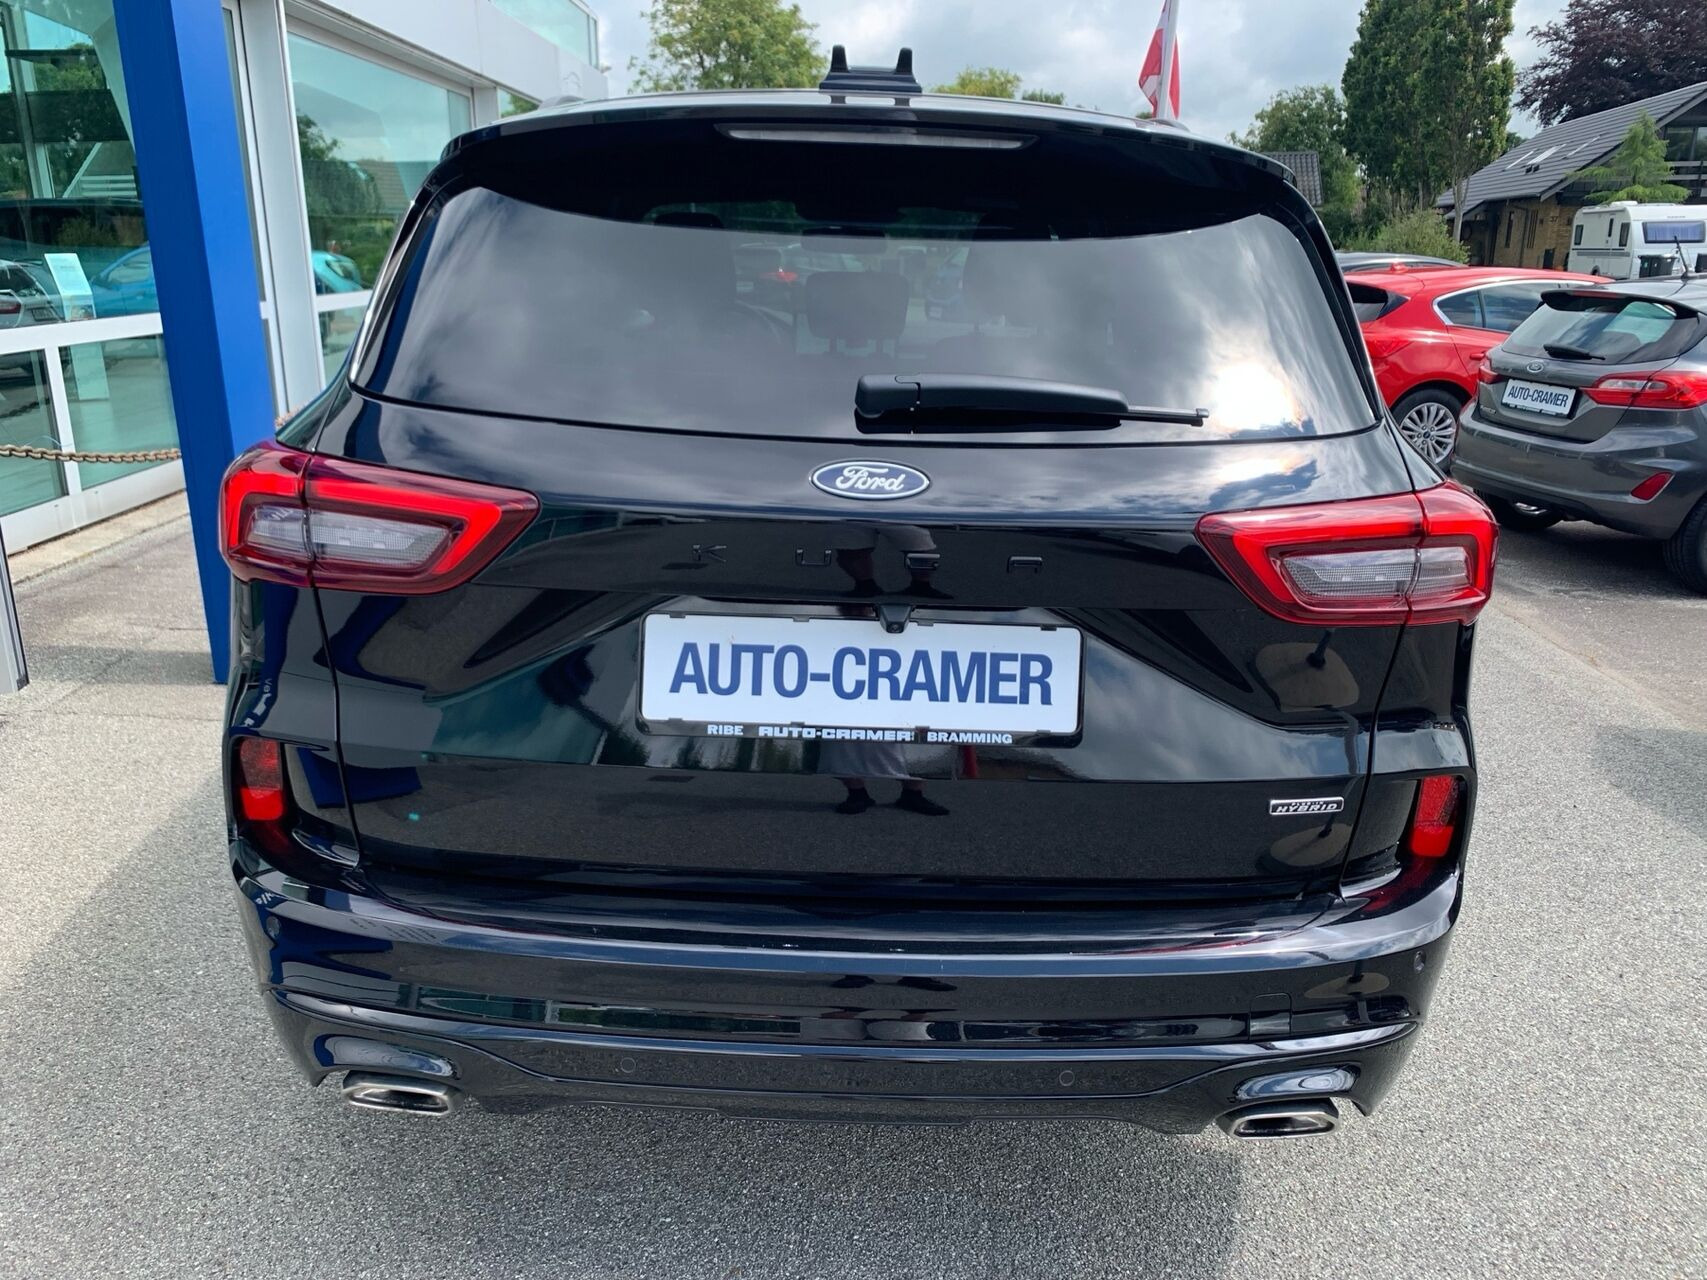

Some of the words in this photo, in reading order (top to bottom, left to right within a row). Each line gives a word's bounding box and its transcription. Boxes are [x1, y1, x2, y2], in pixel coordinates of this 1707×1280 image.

[1508, 385, 1569, 407] AUTO-CRAMER
[835, 465, 906, 491] Ford
[692, 544, 1043, 574] KUGA
[669, 641, 1053, 706] AUTO-CRAMER
[707, 724, 744, 736] RIBE
[927, 731, 1013, 745] BRAMMING
[1276, 803, 1338, 813] HYBRID
